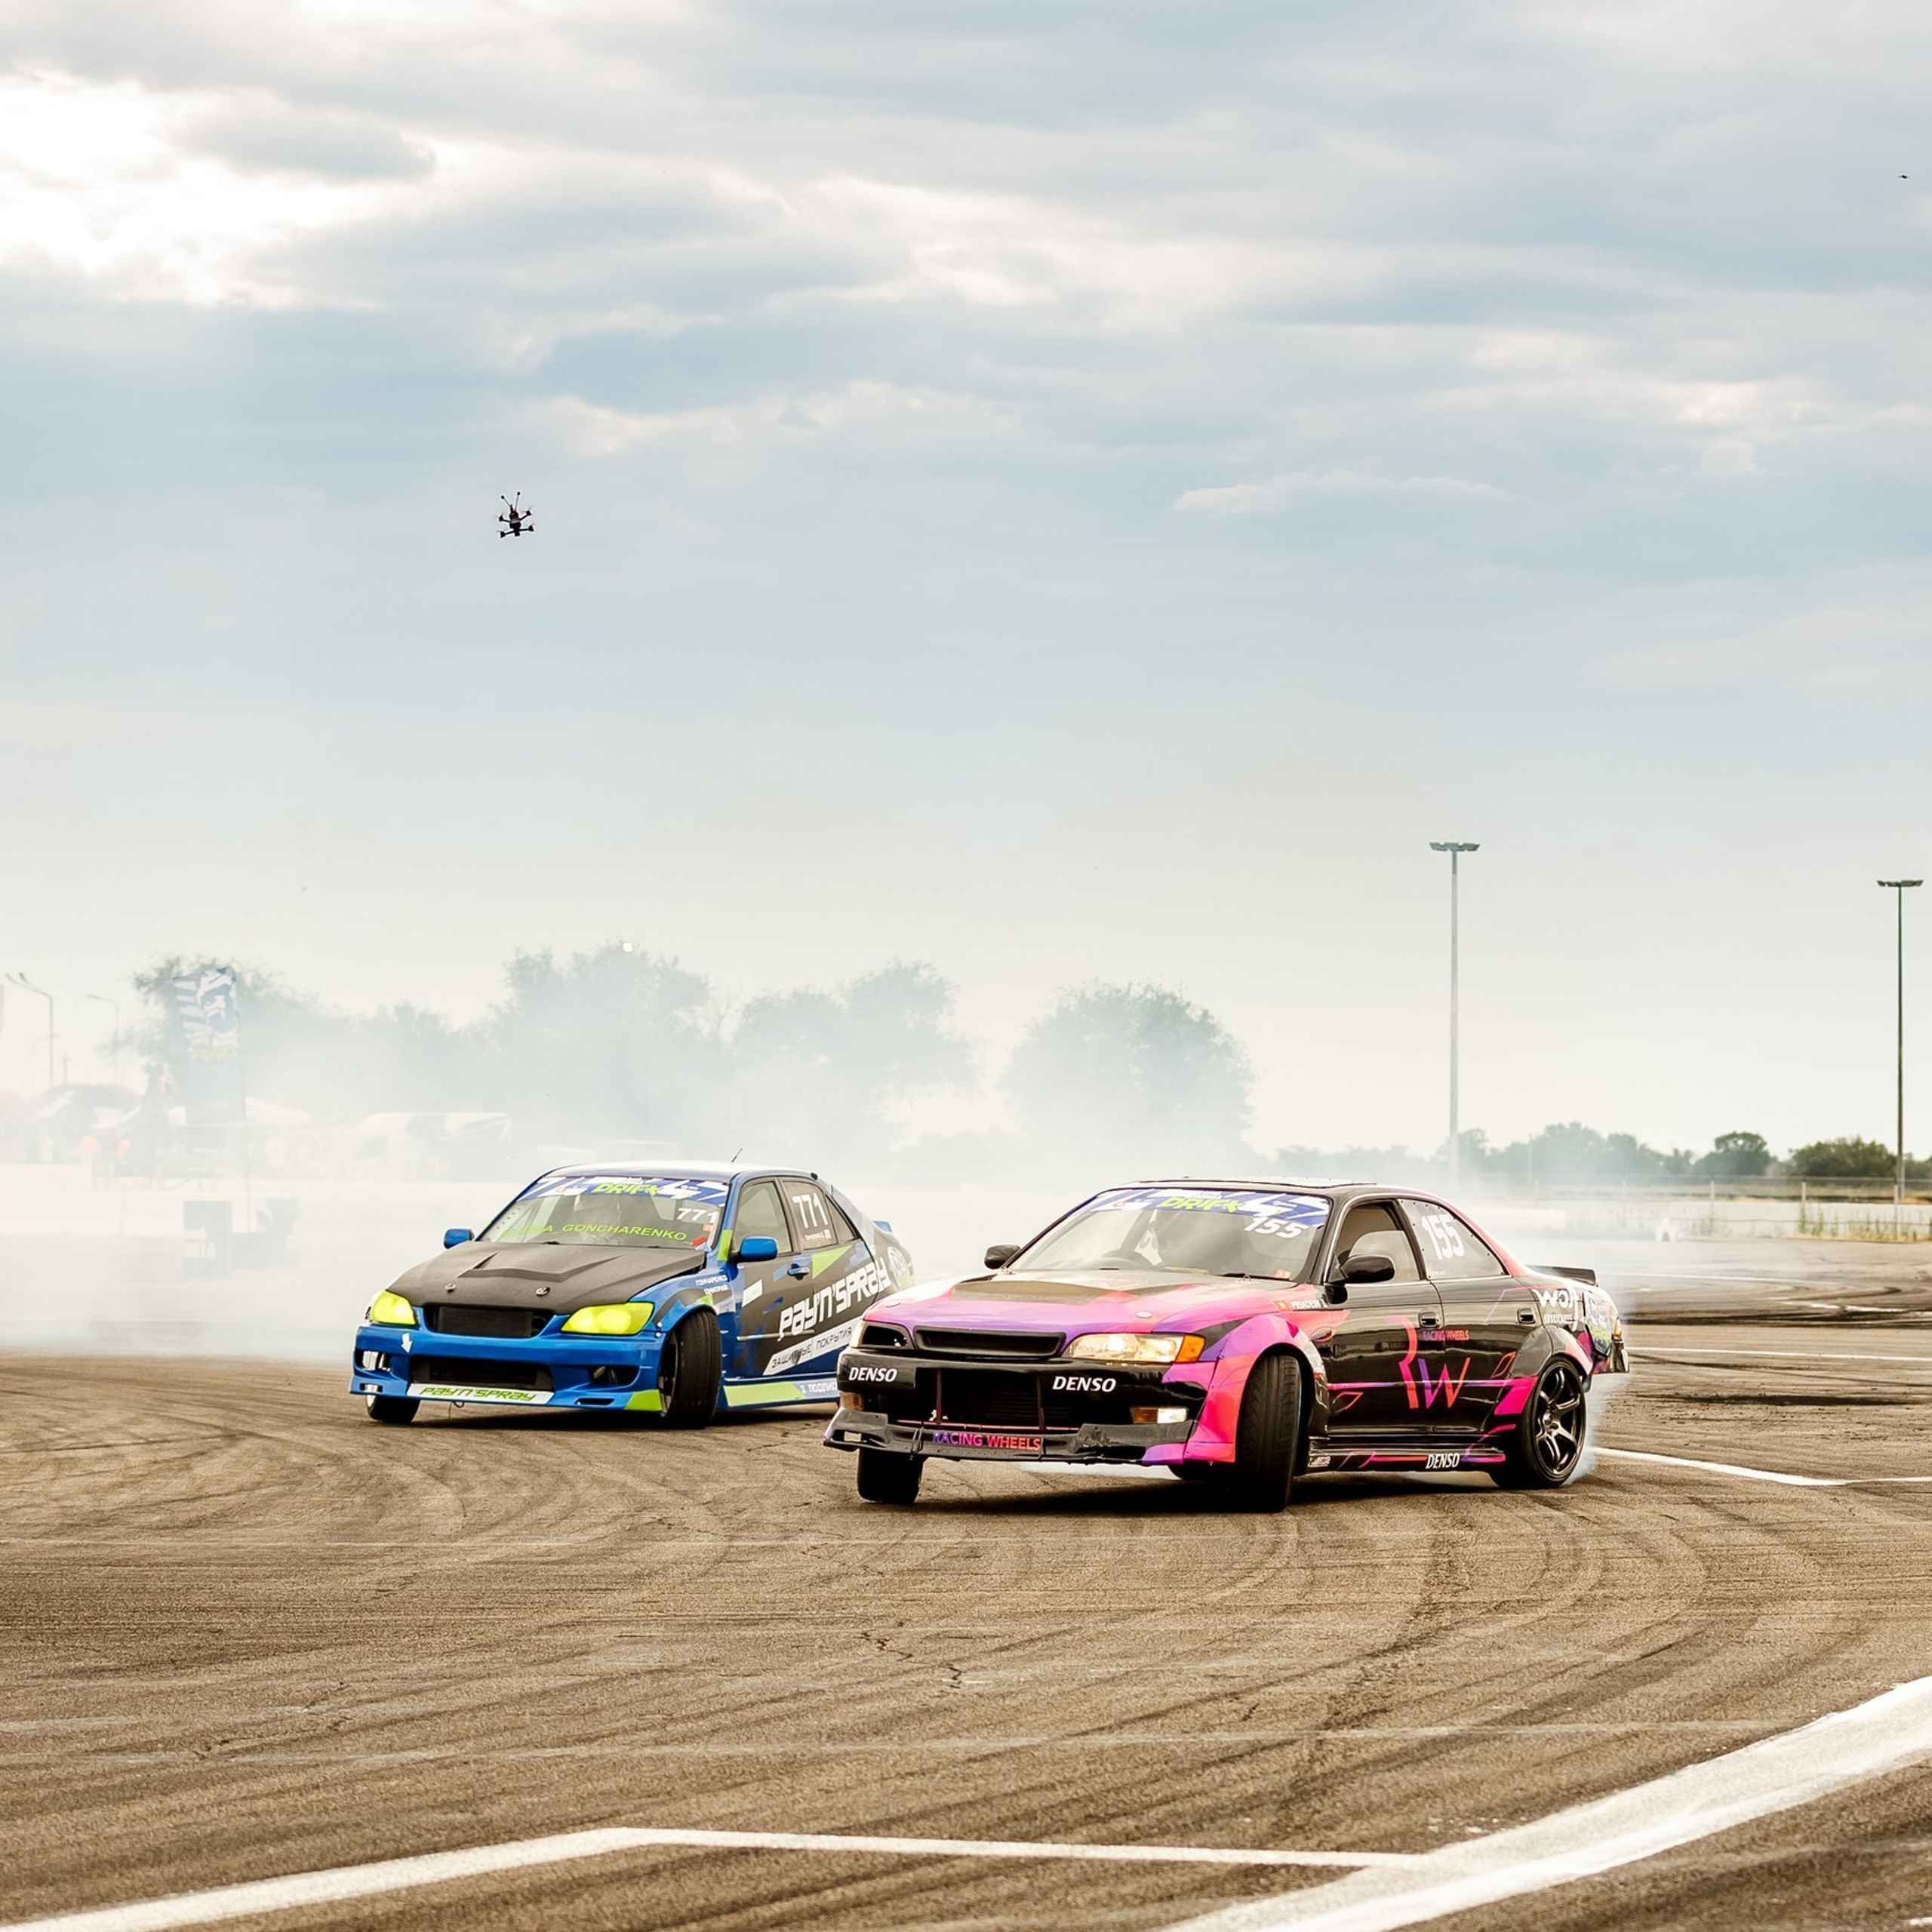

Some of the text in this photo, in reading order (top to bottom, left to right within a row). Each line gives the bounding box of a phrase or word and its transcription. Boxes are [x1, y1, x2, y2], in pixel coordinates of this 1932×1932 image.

[678, 1208, 718, 1223] 771
[792, 1192, 829, 1229] 771
[1244, 1216, 1309, 1239] 155
[1421, 1214, 1466, 1261] 155
[816, 1326, 852, 1350] ПОКРЫТИЯ
[1423, 1330, 1469, 1341] RACING WHEELS
[848, 1367, 898, 1383] DENSO
[1052, 1375, 1117, 1393] DENSO
[933, 1432, 1041, 1451] RACING WHEELS
[1426, 1453, 1460, 1470] DENSO
